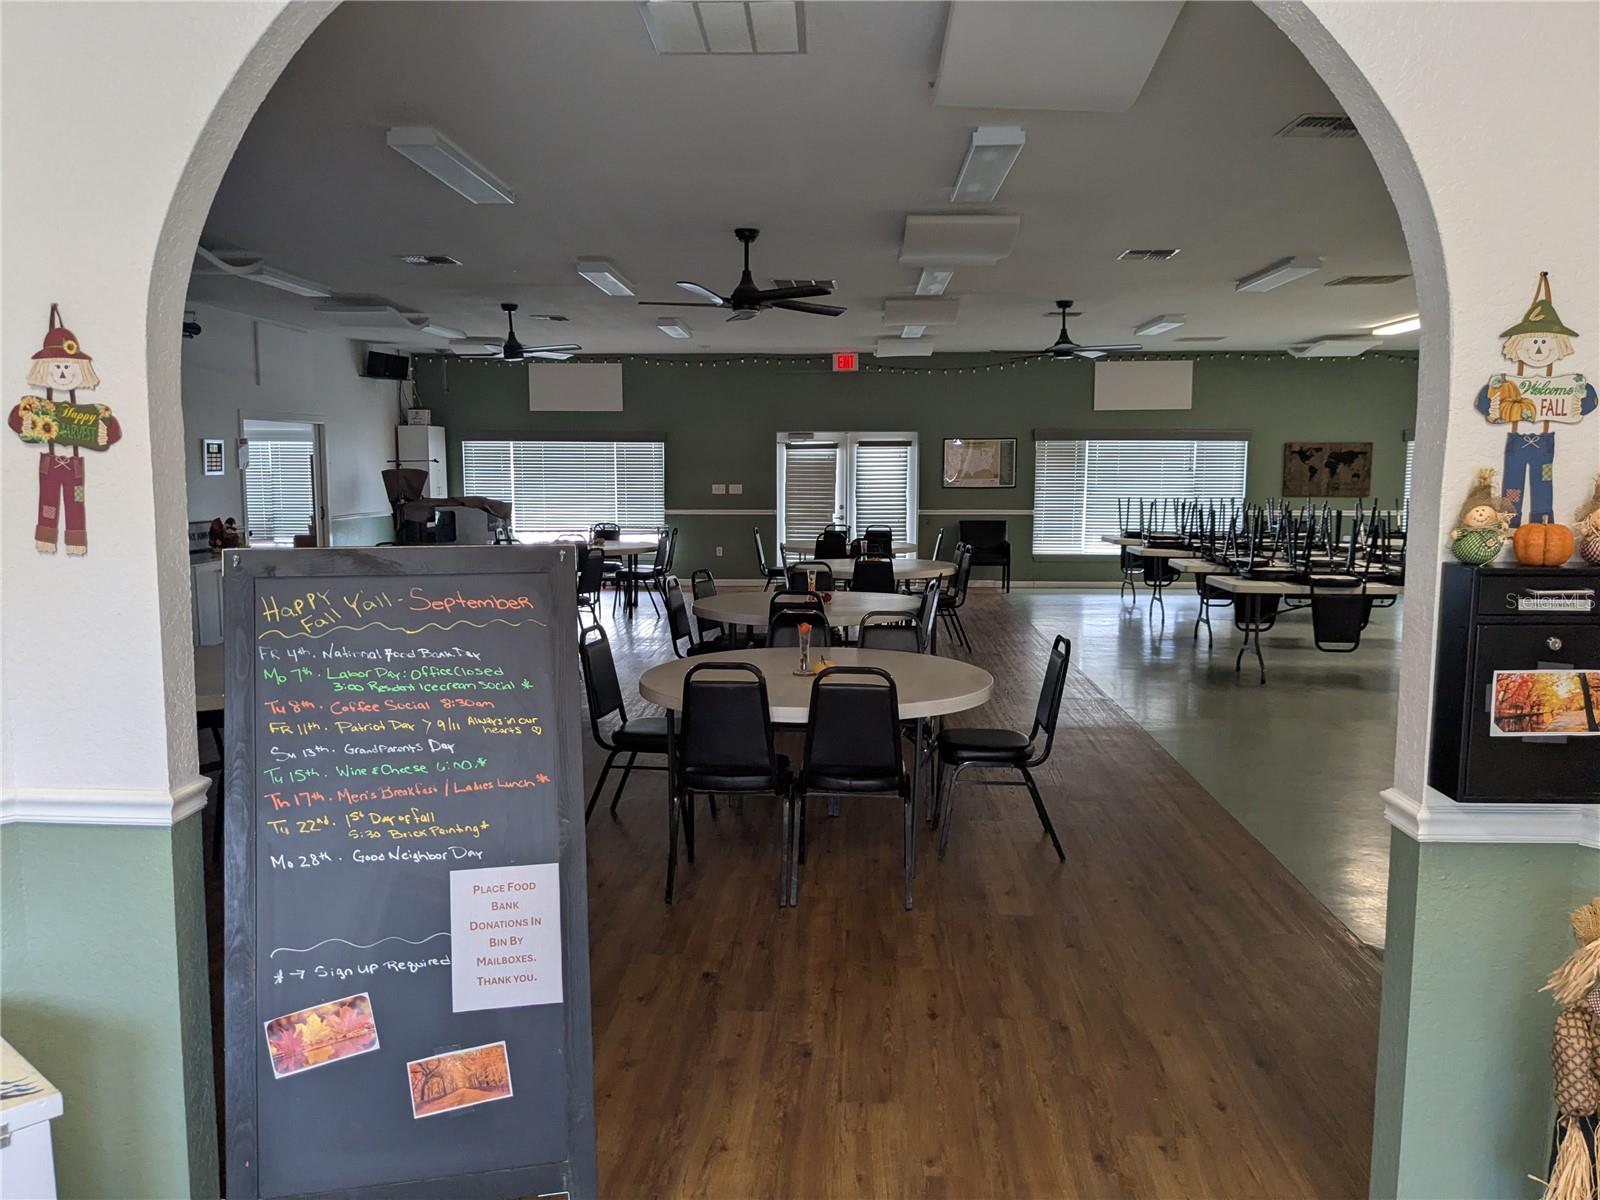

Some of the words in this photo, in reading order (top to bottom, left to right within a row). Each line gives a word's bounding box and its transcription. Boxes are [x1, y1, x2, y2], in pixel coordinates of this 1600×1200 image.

[1520, 380, 1574, 396] Welcome
[61, 404, 97, 425] Happy
[1540, 398, 1568, 416] FALL
[300, 607, 341, 633] Fall
[322, 642, 382, 660] National
[326, 667, 373, 680] Labor
[454, 666, 504, 677] Closed
[333, 682, 364, 692] 3:00
[264, 700, 286, 715] Tu
[330, 701, 380, 715] Coffee
[384, 699, 431, 711] Social
[440, 698, 495, 709] 8:30am
[334, 719, 386, 734] Patriot
[387, 719, 416, 732] Day
[437, 717, 461, 731] 9/11
[467, 716, 504, 726] Always
[504, 716, 516, 725] in
[518, 717, 538, 725] our
[482, 726, 522, 735] hearts
[428, 738, 455, 754] Day
[264, 767, 283, 784] Tu
[335, 764, 367, 778] Wine
[337, 787, 377, 805] Men's
[378, 782, 438, 800] Breakfast
[454, 782, 494, 793] Ladies
[267, 820, 290, 835] Tu
[368, 812, 396, 826] Day
[348, 829, 381, 839] 5:30
[387, 829, 428, 839] Brick
[270, 854, 293, 869] Mo
[353, 849, 385, 863] Good
[388, 845, 448, 862] Neighbor
[447, 845, 483, 860] Day
[473, 884, 505, 894] PLACE
[508, 882, 536, 892] FOOD
[491, 901, 519, 911] BANK
[470, 918, 528, 931] DONATIONS
[531, 917, 542, 926] IN
[489, 937, 507, 947] BIN
[510, 936, 523, 945] BY
[314, 965, 353, 980] Sign
[383, 954, 451, 973] Required
[476, 954, 537, 967] MAILBOXES.
[477, 976, 511, 986] THANK
